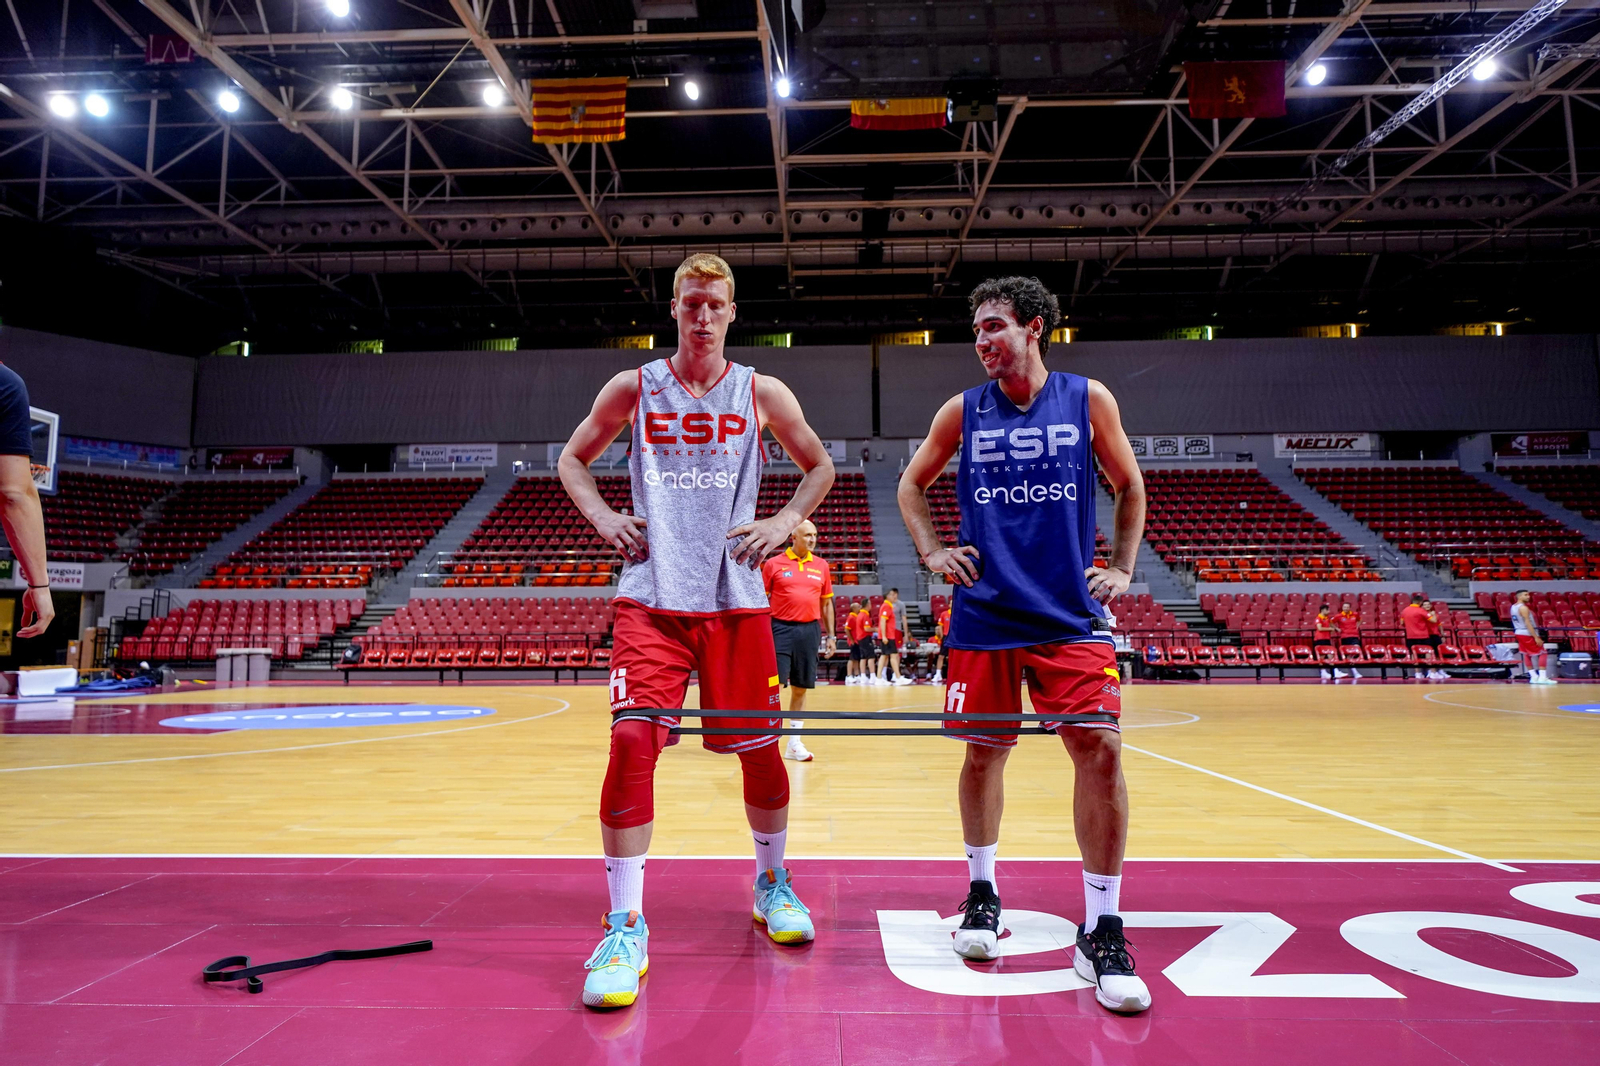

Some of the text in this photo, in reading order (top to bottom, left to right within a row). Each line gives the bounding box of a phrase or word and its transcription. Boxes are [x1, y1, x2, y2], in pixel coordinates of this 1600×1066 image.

[645, 412, 747, 444] ESP
[641, 446, 740, 456] BASKETBAL
[971, 423, 1080, 463] ESP
[970, 461, 1082, 474] BASKETBALL
[974, 480, 1077, 504] endesa
[768, 693, 780, 705] ES
